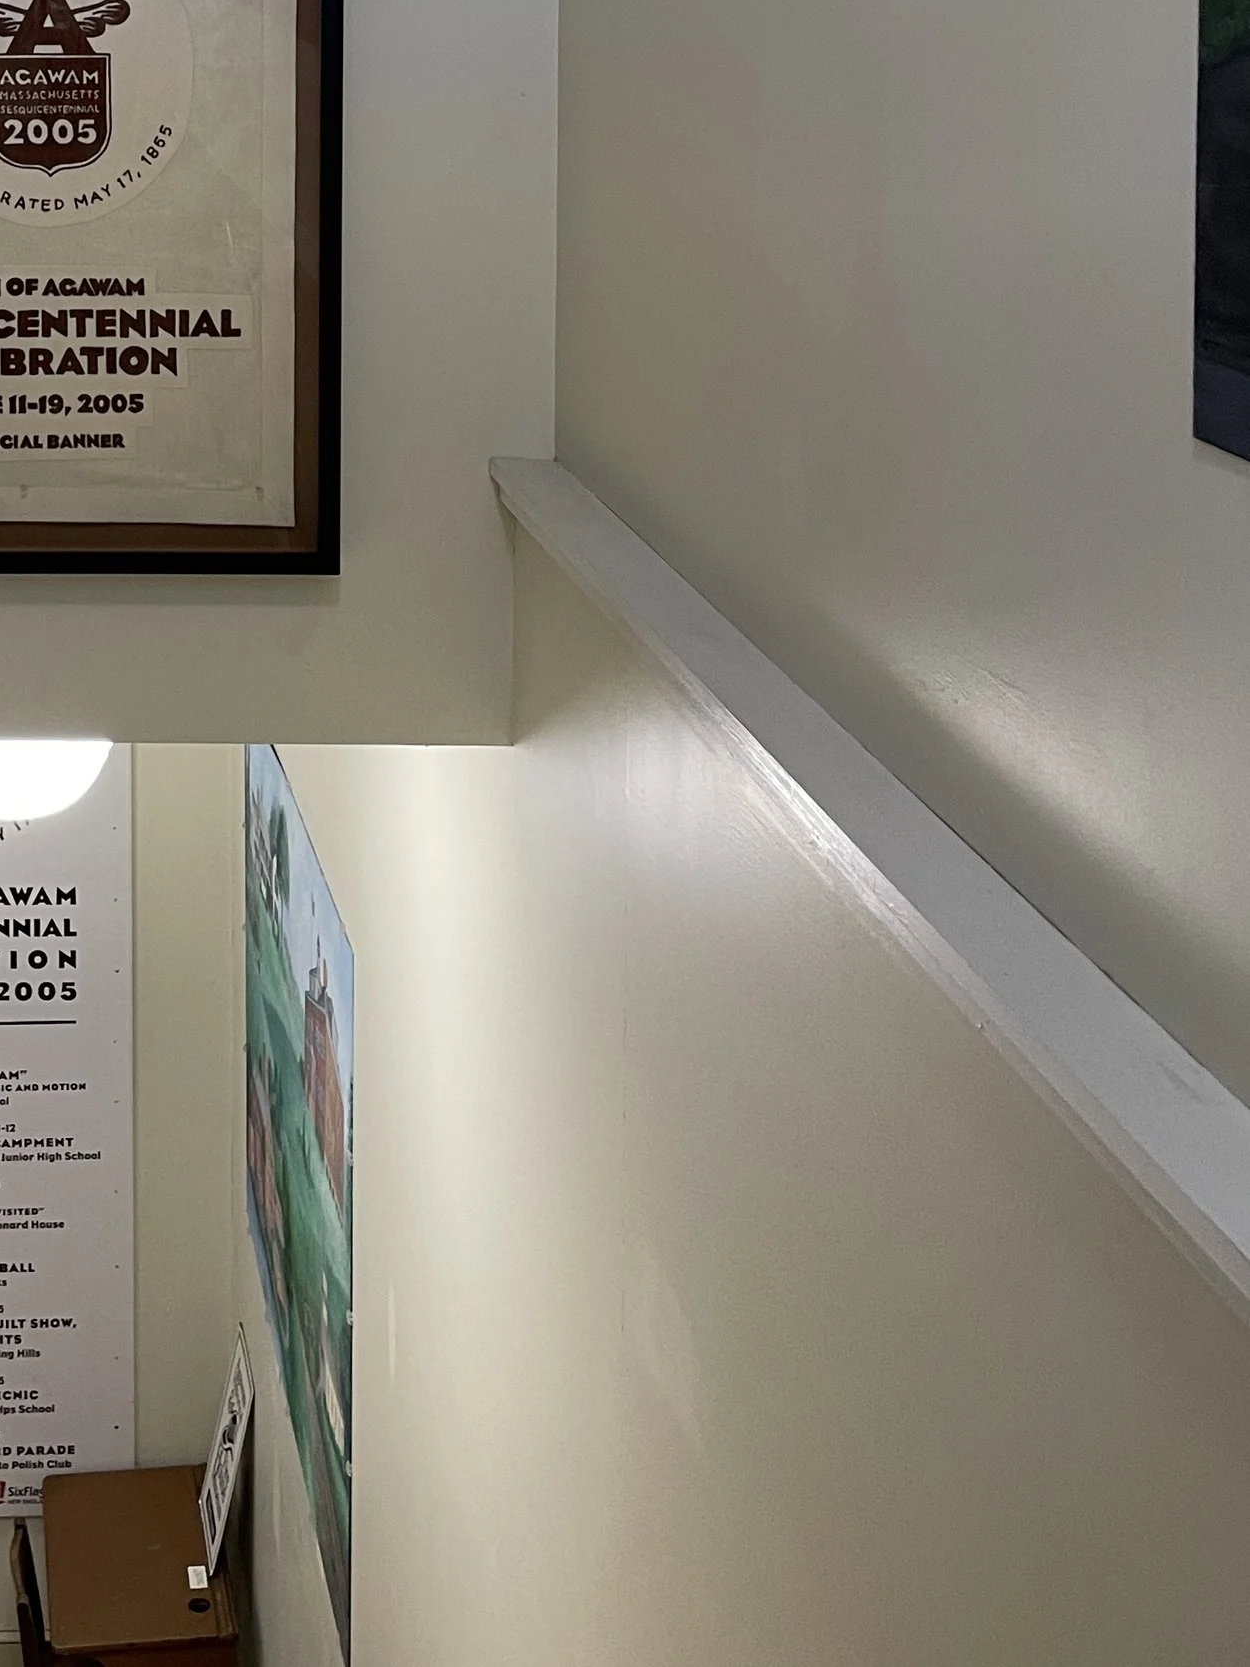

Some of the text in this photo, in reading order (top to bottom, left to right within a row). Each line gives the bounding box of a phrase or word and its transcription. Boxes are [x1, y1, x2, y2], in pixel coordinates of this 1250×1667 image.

[0, 69, 100, 85] AGAWAM
[0, 89, 100, 101] MASSACHUSETTS
[0, 104, 100, 114] SESQUICENTENNIAL
[3, 119, 98, 145] 2005
[73, 183, 112, 210] MAY
[116, 169, 142, 189] 17,
[5, 277, 39, 297] OF
[41, 276, 145, 297] AGAWAM
[8, 393, 72, 417] 11-19,
[77, 393, 144, 414] 2005
[46, 432, 126, 449] BANNER
[14, 1083, 39, 1092] AND
[41, 1082, 86, 1091] MOTION
[0, 1152, 35, 1162] Junior
[36, 1151, 62, 1163] High
[63, 1150, 101, 1161] School
[30, 1219, 65, 1229] House
[16, 1348, 41, 1358] Hills
[17, 1403, 55, 1414] School
[16, 1444, 75, 1456] PARADE
[10, 1459, 44, 1470] Polish
[46, 1459, 72, 1469] Club
